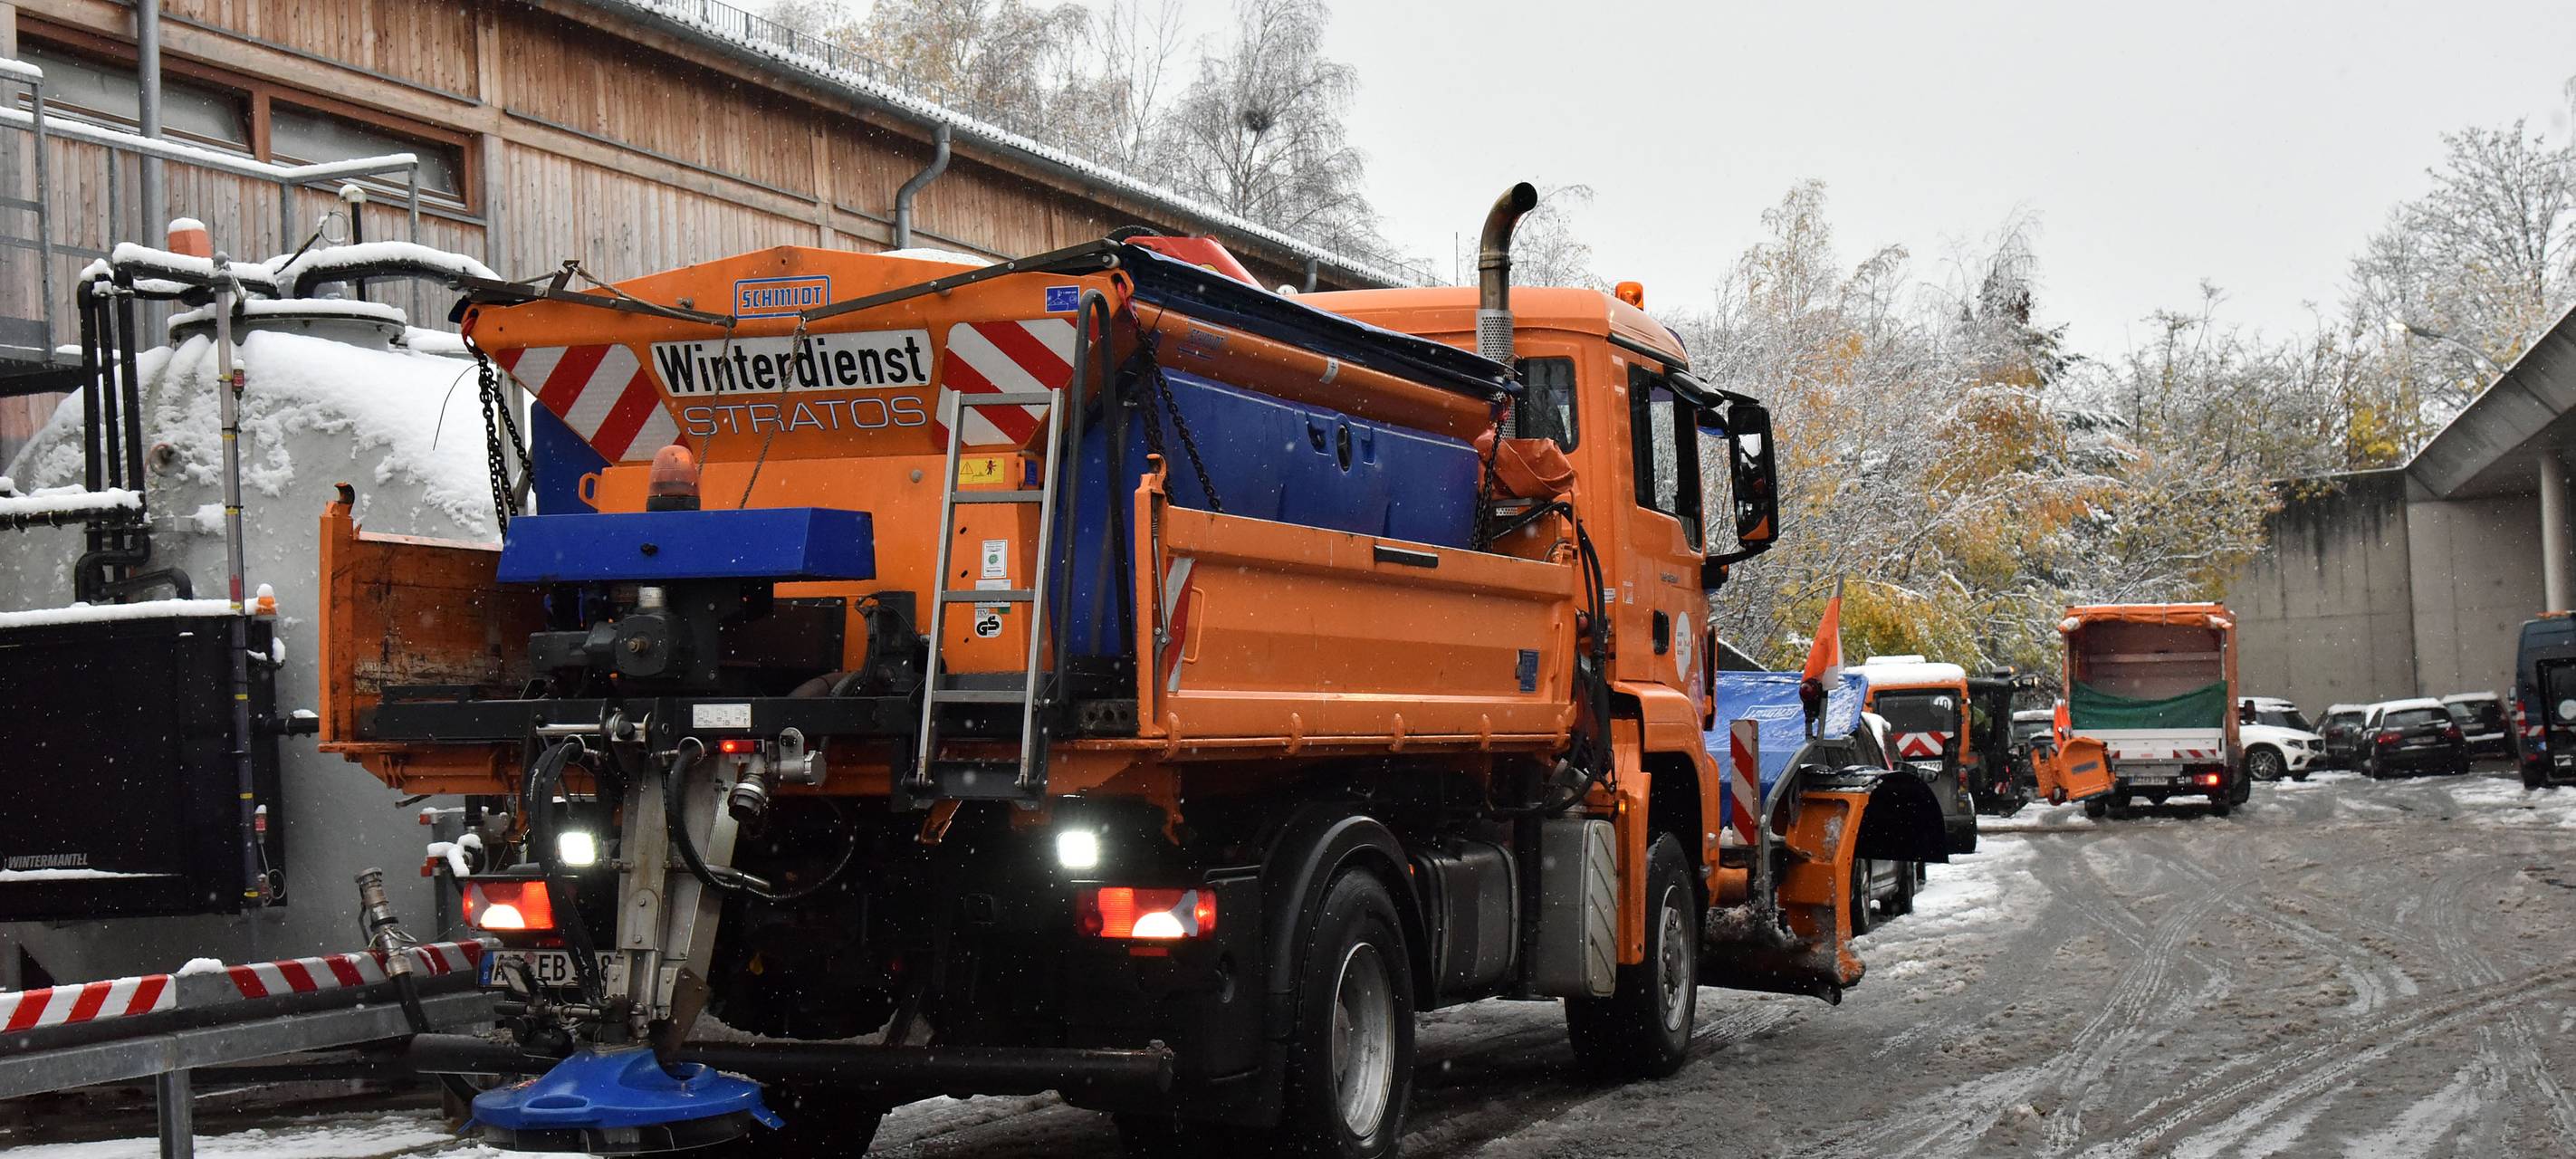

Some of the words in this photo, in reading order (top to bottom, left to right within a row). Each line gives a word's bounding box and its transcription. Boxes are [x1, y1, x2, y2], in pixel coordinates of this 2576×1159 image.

[742, 286, 822, 309] SCHMIDT
[656, 336, 926, 393] Winterdienst
[683, 397, 927, 436] STRATOS
[977, 616, 1000, 636] GS
[8, 853, 88, 868] WINTERMANTEL
[539, 954, 567, 982] EB
